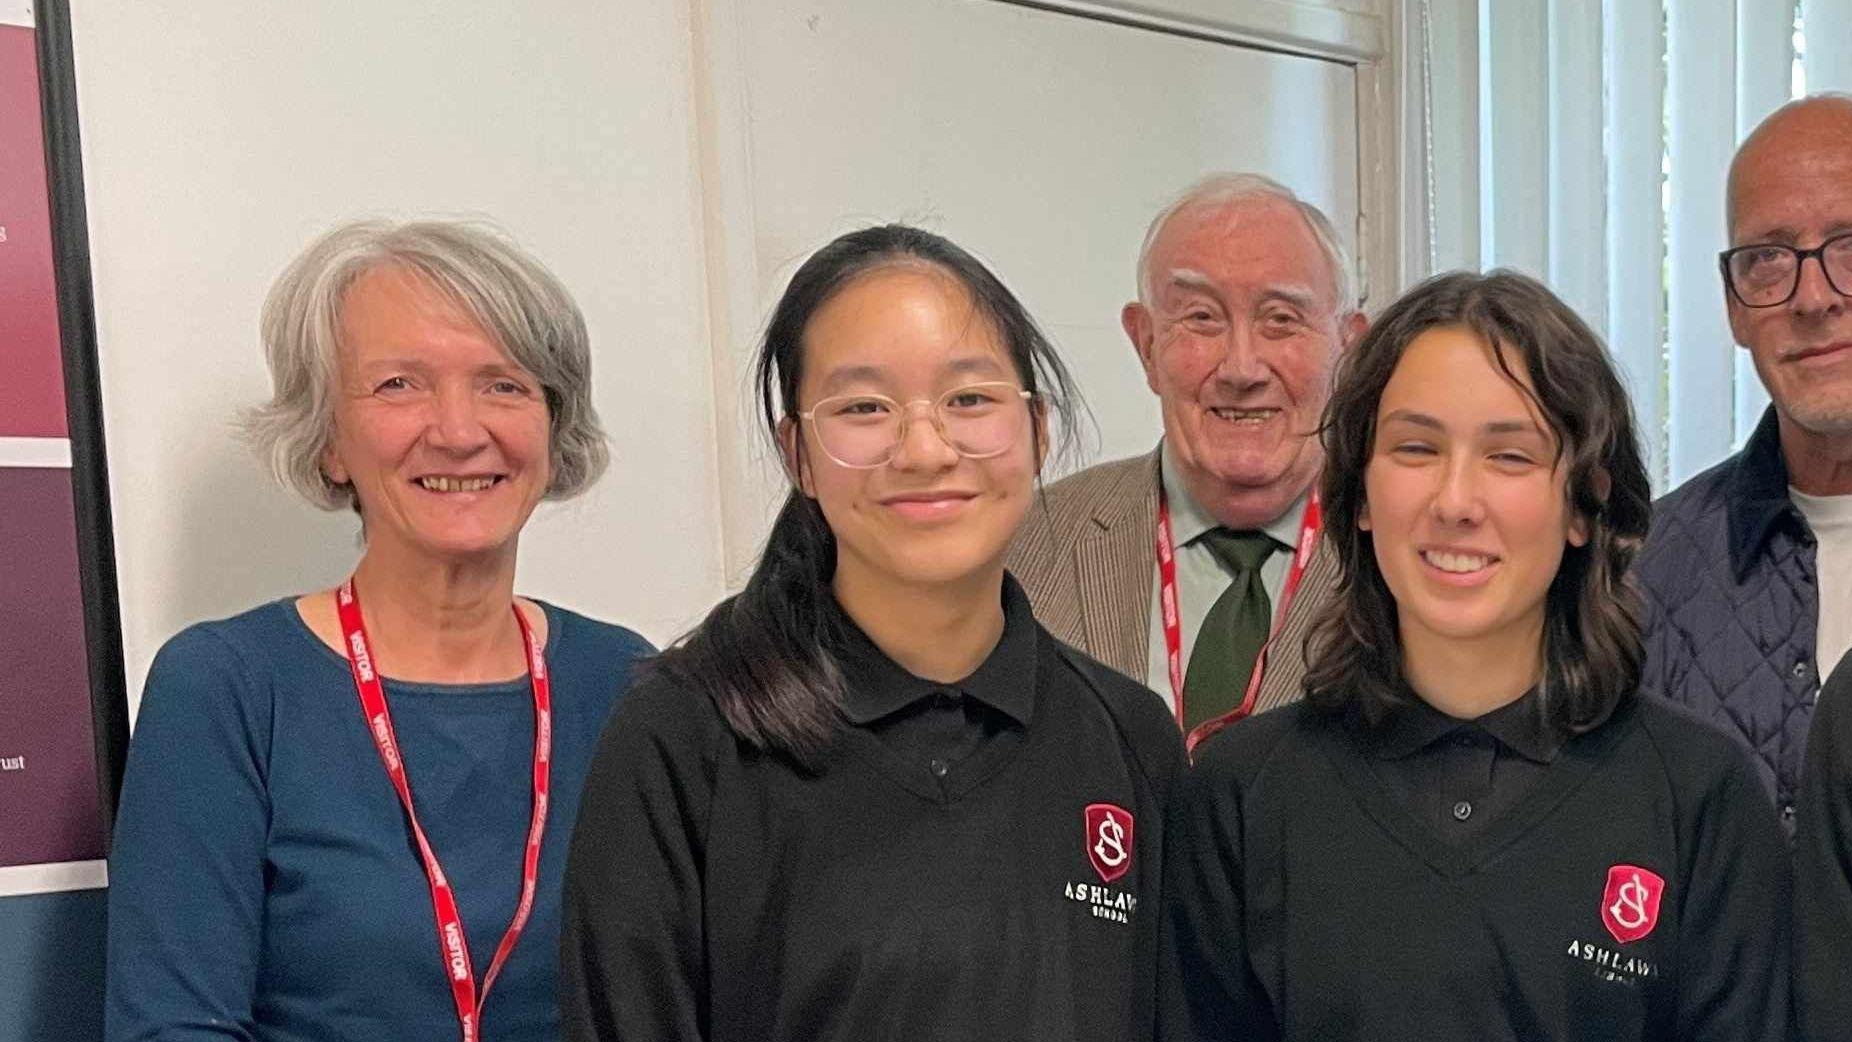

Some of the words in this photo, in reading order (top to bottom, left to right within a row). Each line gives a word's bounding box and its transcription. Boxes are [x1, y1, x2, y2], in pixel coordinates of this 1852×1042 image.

[350, 629, 374, 684] VISITOR
[373, 712, 399, 772] VISITOR
[1064, 881, 1138, 911] ASHLAW
[444, 921, 468, 982] VISITOR
